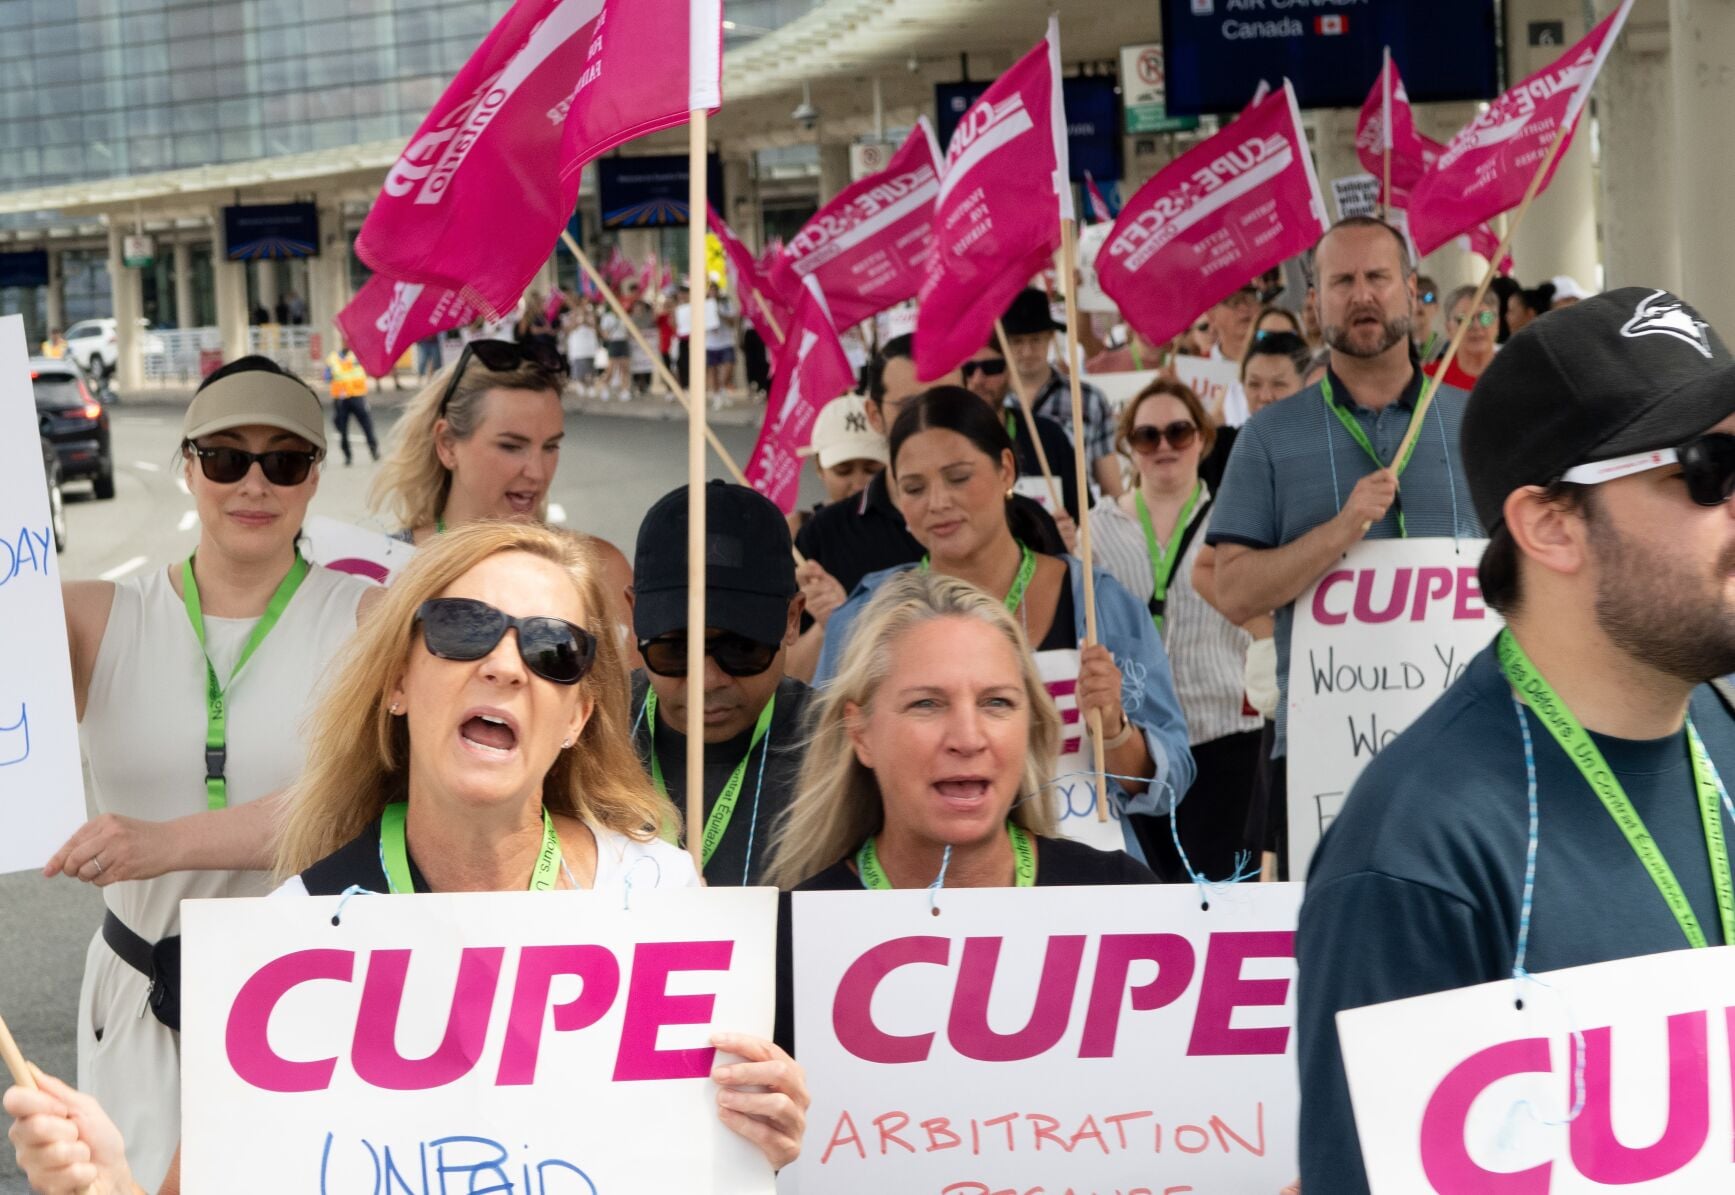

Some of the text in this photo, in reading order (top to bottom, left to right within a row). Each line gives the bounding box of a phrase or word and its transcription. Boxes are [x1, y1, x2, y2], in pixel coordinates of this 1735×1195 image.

[1222, 16, 1303, 40] Canada
[1540, 28, 1554, 45] 6
[1311, 567, 1486, 626] CUPE
[1310, 645, 1425, 695] WOULD
[540, 824, 557, 875] tours.
[224, 940, 735, 1093] CUPE
[831, 931, 1296, 1064] CUPE
[1420, 1006, 1735, 1195] CU
[821, 1102, 1266, 1165] ARBITRATION
